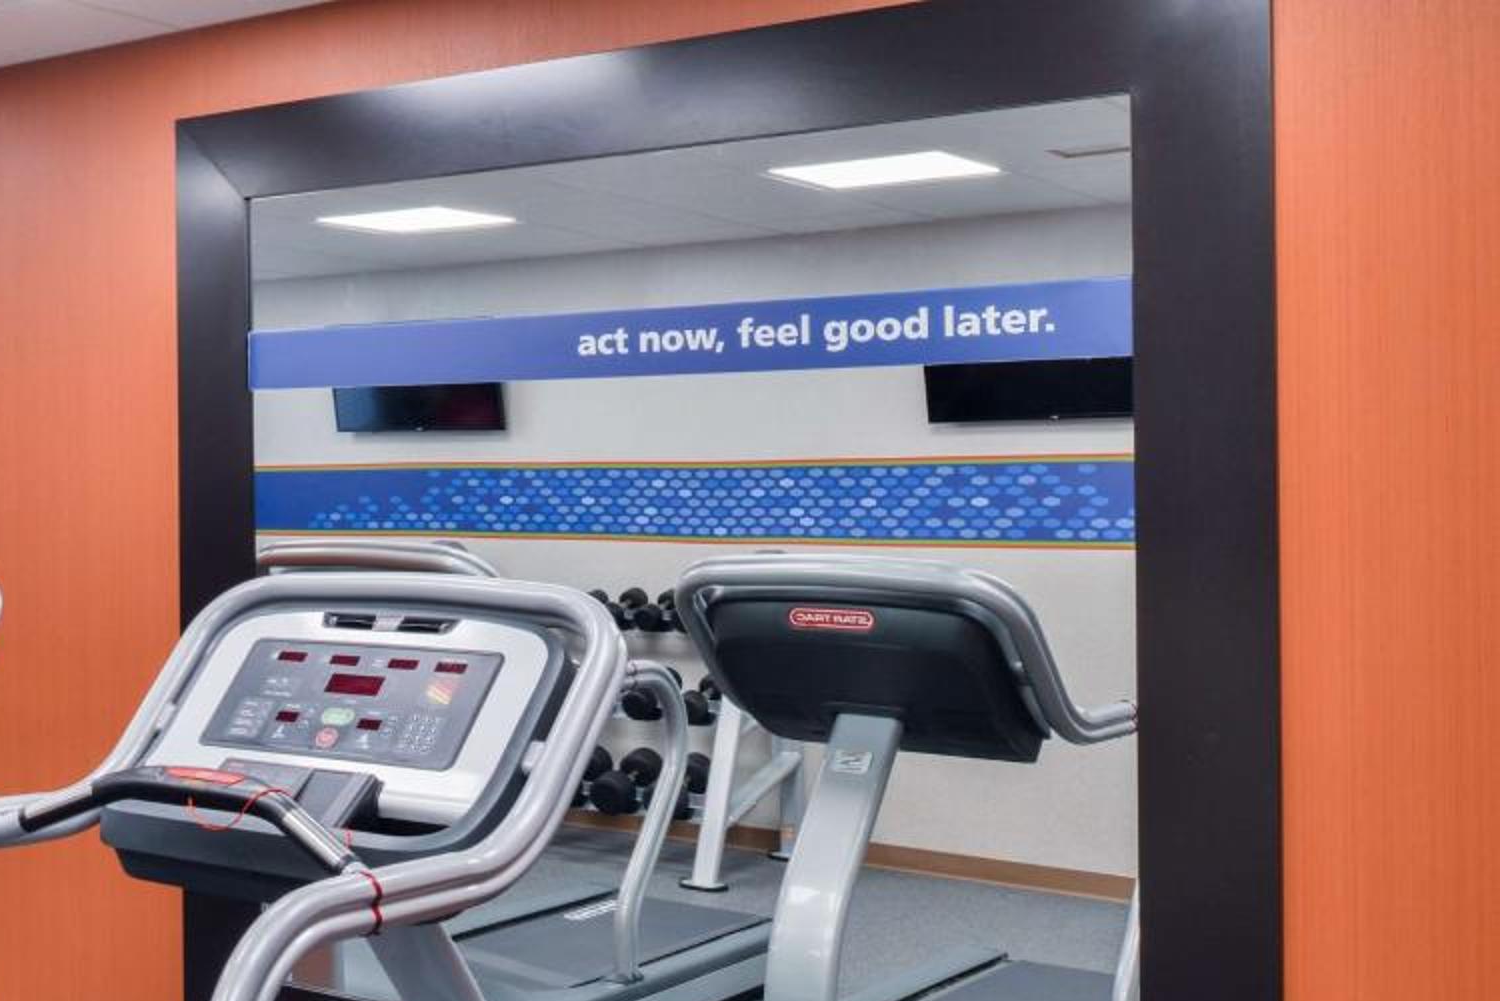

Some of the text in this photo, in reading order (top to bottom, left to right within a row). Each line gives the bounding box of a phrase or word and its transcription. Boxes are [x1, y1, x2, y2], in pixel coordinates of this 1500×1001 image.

[577, 304, 1056, 356] act now, feel good later.
